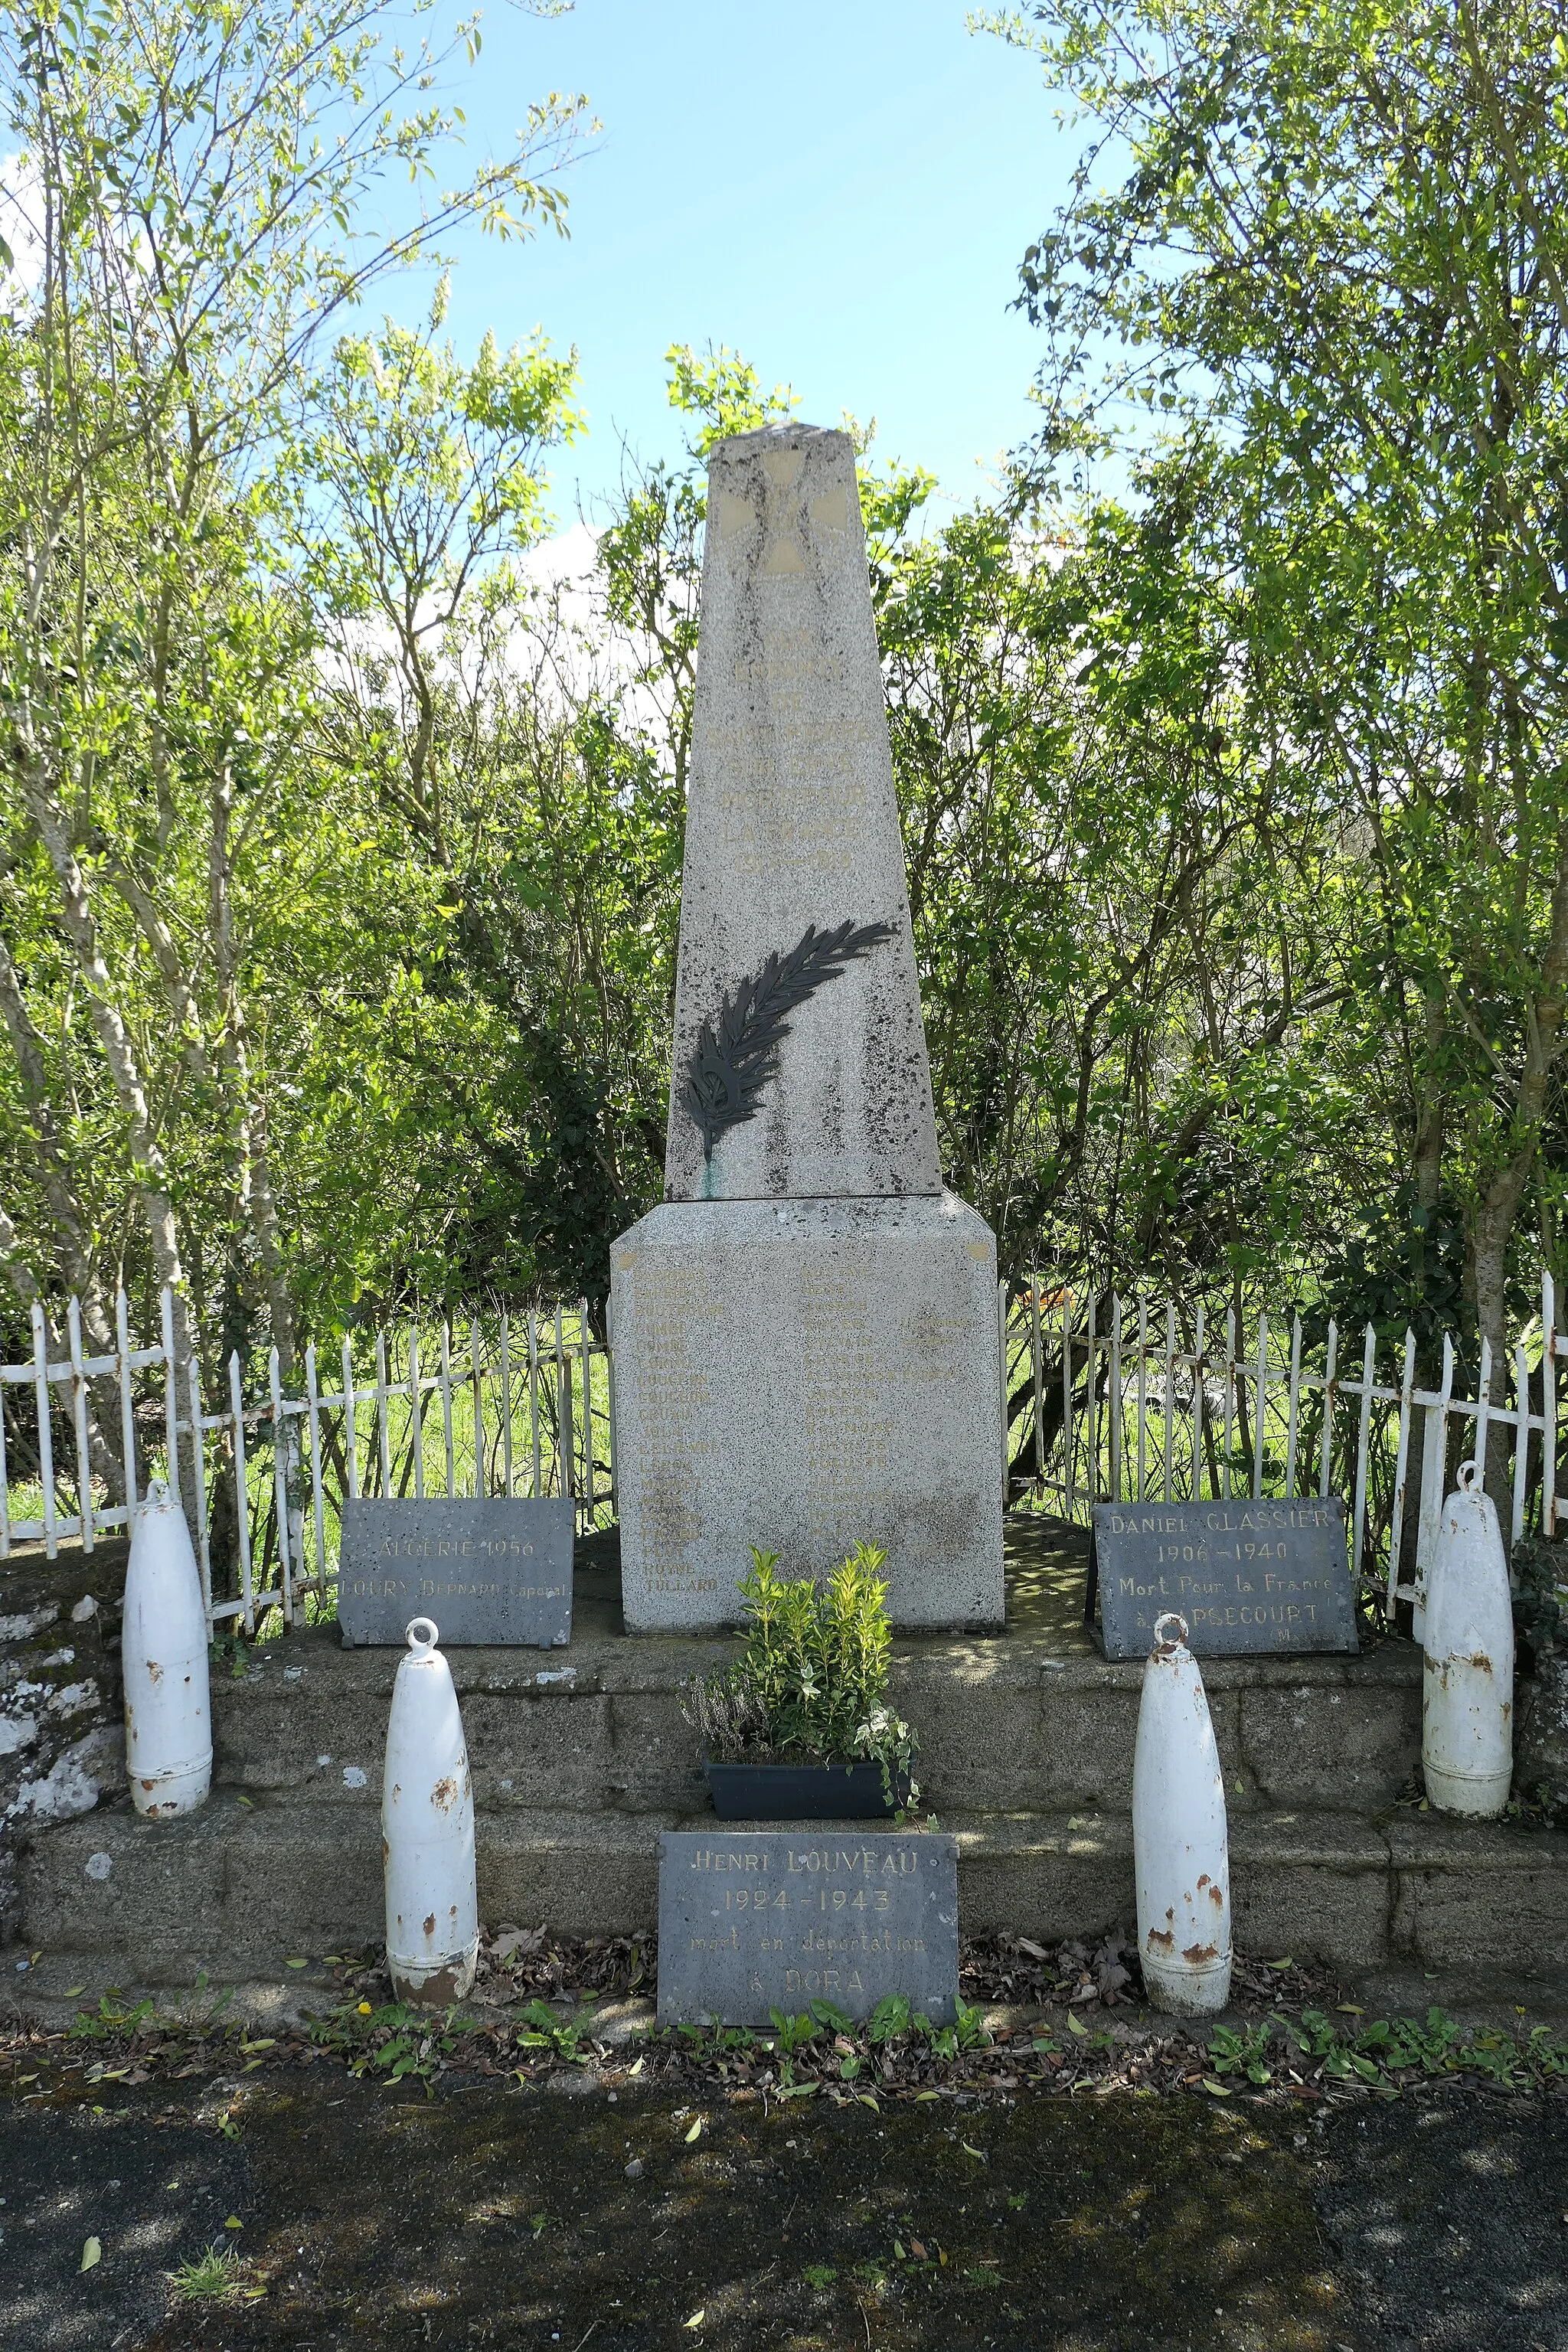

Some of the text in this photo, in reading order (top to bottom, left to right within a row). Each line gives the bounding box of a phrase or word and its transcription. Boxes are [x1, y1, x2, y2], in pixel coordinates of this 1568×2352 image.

[734, 658, 842, 684] ENFANTS
[773, 692, 805, 712] DE
[804, 784, 867, 807] POUR
[724, 816, 861, 843] LA FRANCE
[1110, 1515, 1187, 1533] DANIEL
[487, 1540, 534, 1557] 1956
[341, 1579, 413, 1598] LOURY
[1119, 1572, 1334, 1596] Mort Pour la France
[787, 1848, 918, 1873] LOUVEAU
[691, 1928, 741, 1951] mort
[761, 1937, 785, 1951] en
[786, 1969, 866, 1992] DORA
